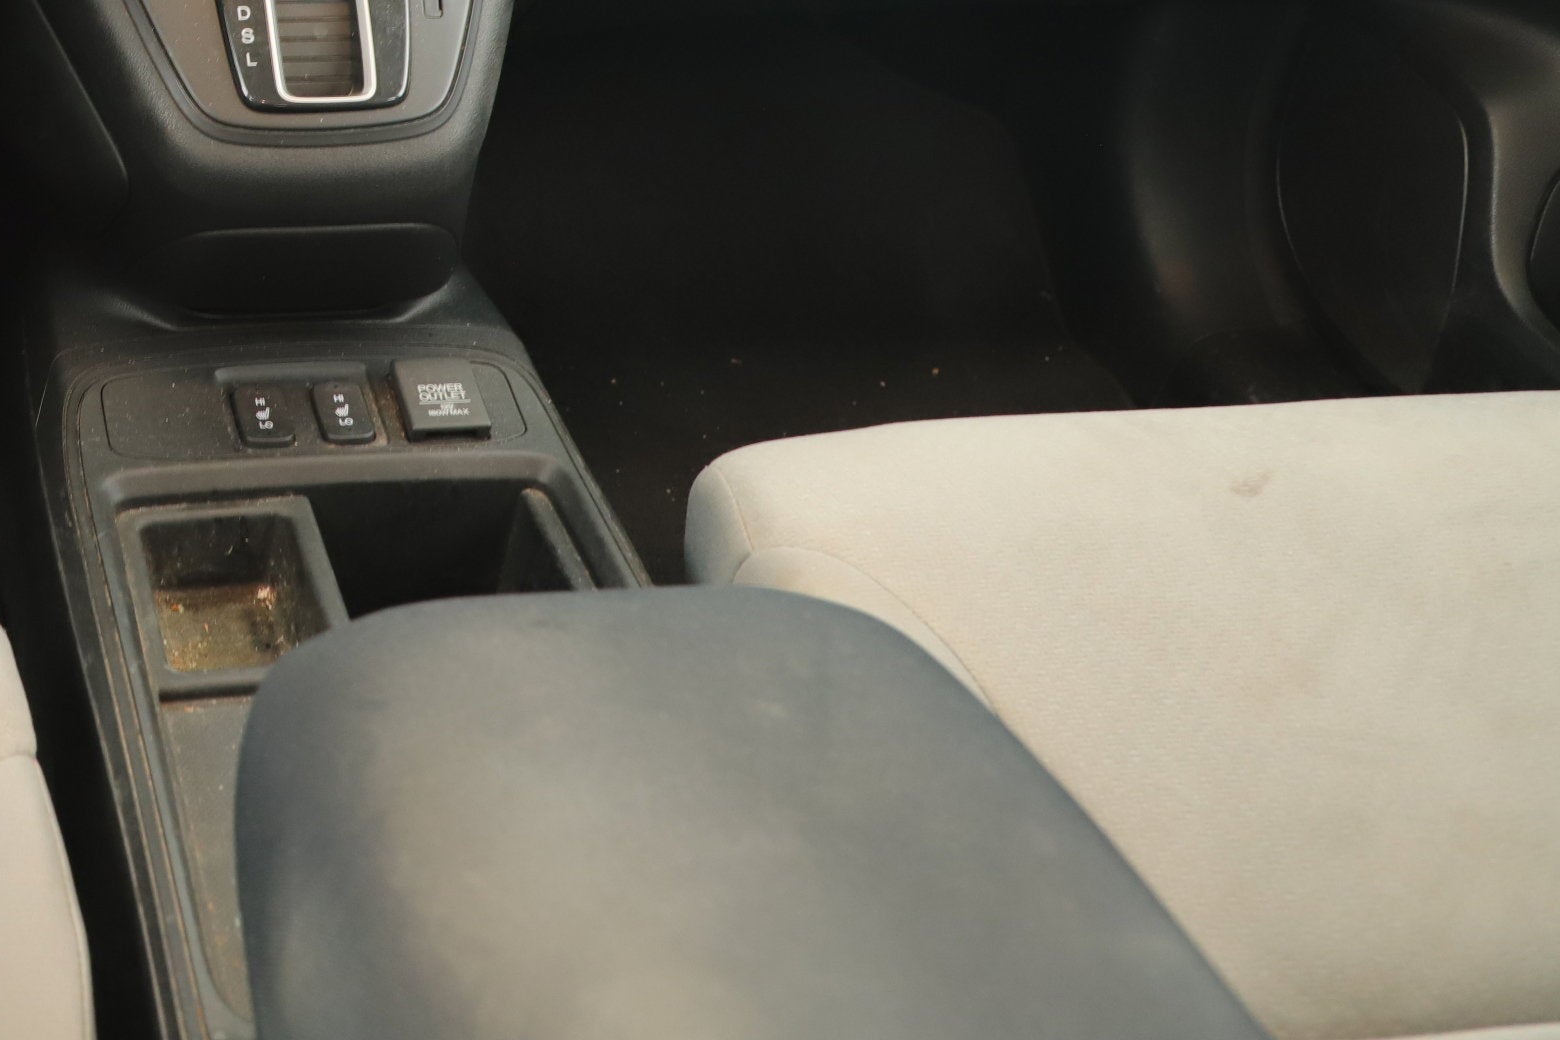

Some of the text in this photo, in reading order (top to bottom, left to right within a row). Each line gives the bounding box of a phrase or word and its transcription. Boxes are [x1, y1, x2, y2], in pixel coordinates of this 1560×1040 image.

[237, 5, 251, 21] D
[241, 28, 255, 44] S
[246, 52, 258, 67] L
[417, 382, 463, 393] POWER
[333, 394, 345, 403] HI
[419, 390, 467, 401] OUTLET
[254, 397, 266, 407] HI
[259, 421, 274, 430] LO
[339, 417, 354, 427] LO
